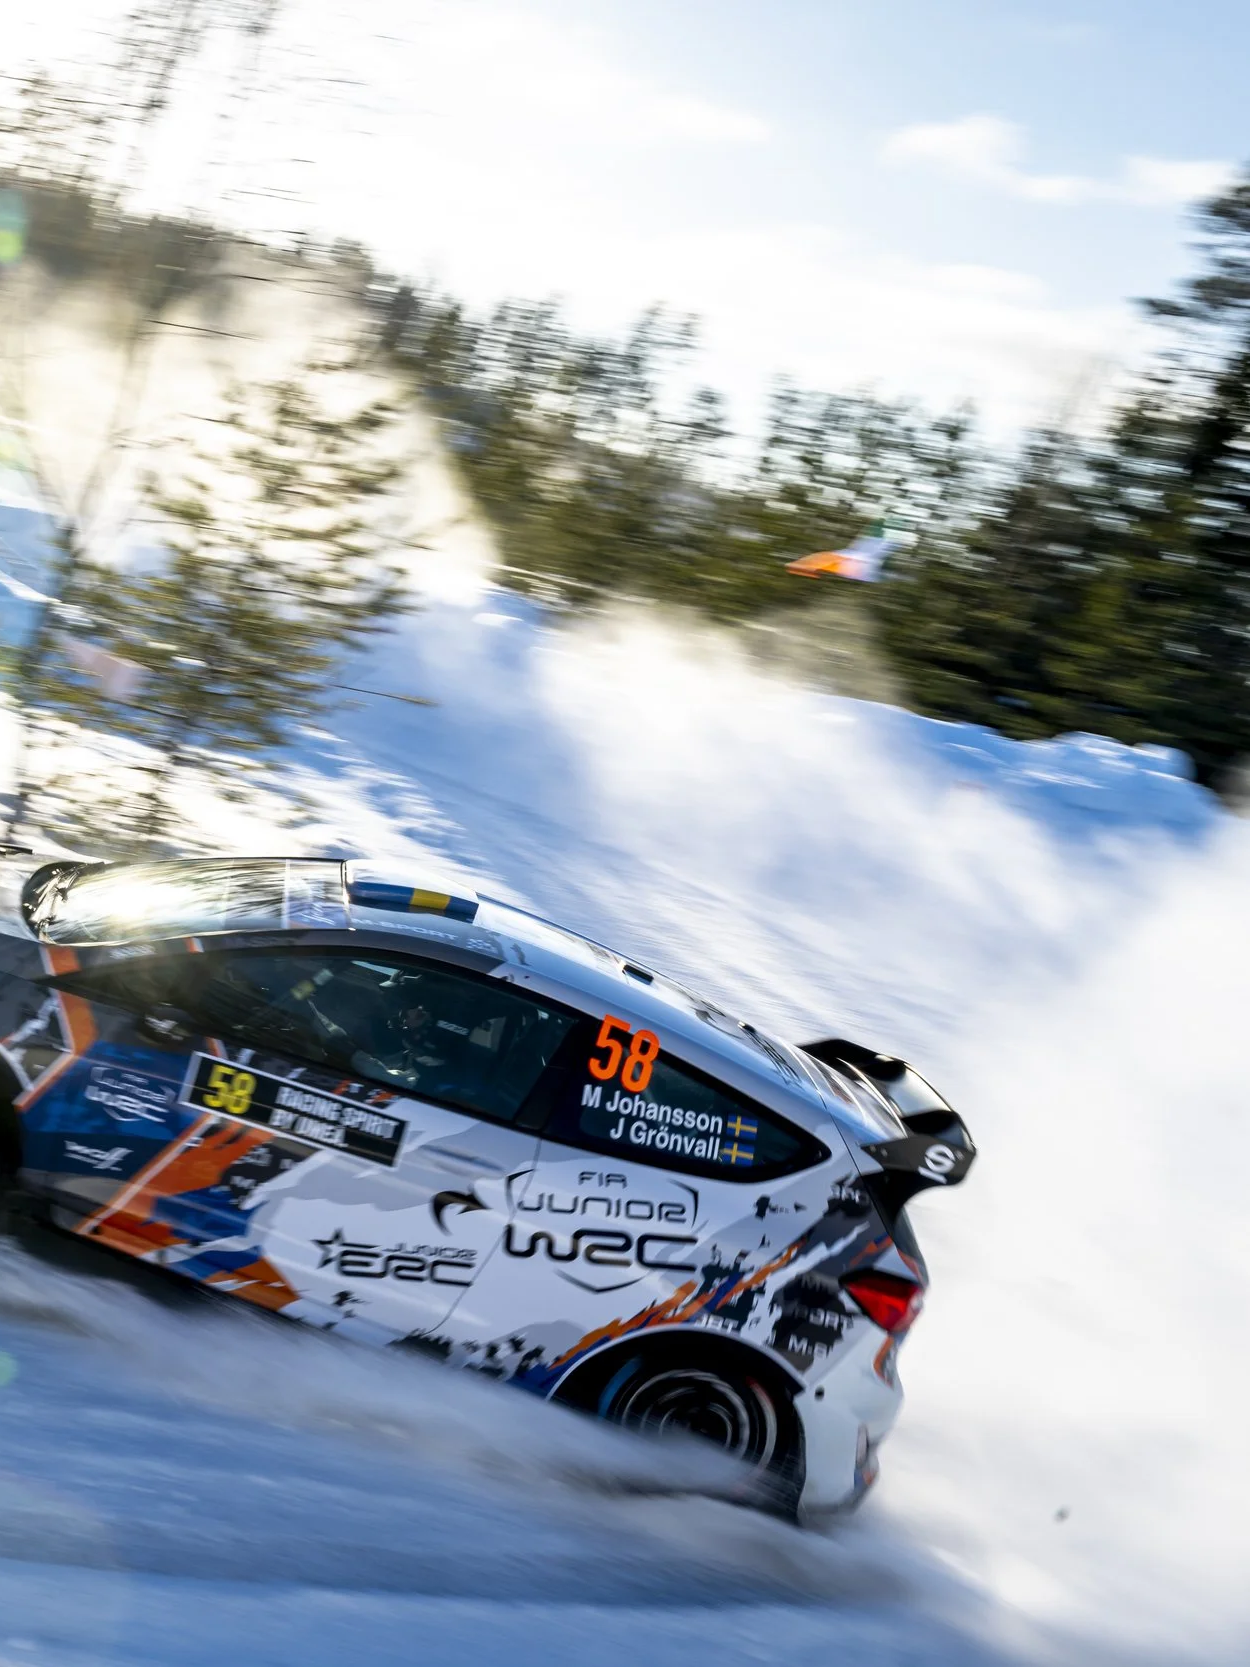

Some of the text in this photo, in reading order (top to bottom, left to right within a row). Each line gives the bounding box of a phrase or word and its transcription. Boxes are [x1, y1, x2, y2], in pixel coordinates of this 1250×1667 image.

[588, 1014, 660, 1093] 58
[203, 1064, 257, 1114] 58
[581, 1084, 723, 1135] M Johansson
[268, 1108, 296, 1129] BY
[275, 1086, 400, 1139] RACING SPIRIT
[609, 1118, 721, 1161] J Grönvall
[578, 1171, 628, 1189] FIA
[517, 1192, 687, 1223] JUNIOR
[337, 1249, 476, 1287] ERC
[504, 1223, 699, 1272] WRC
